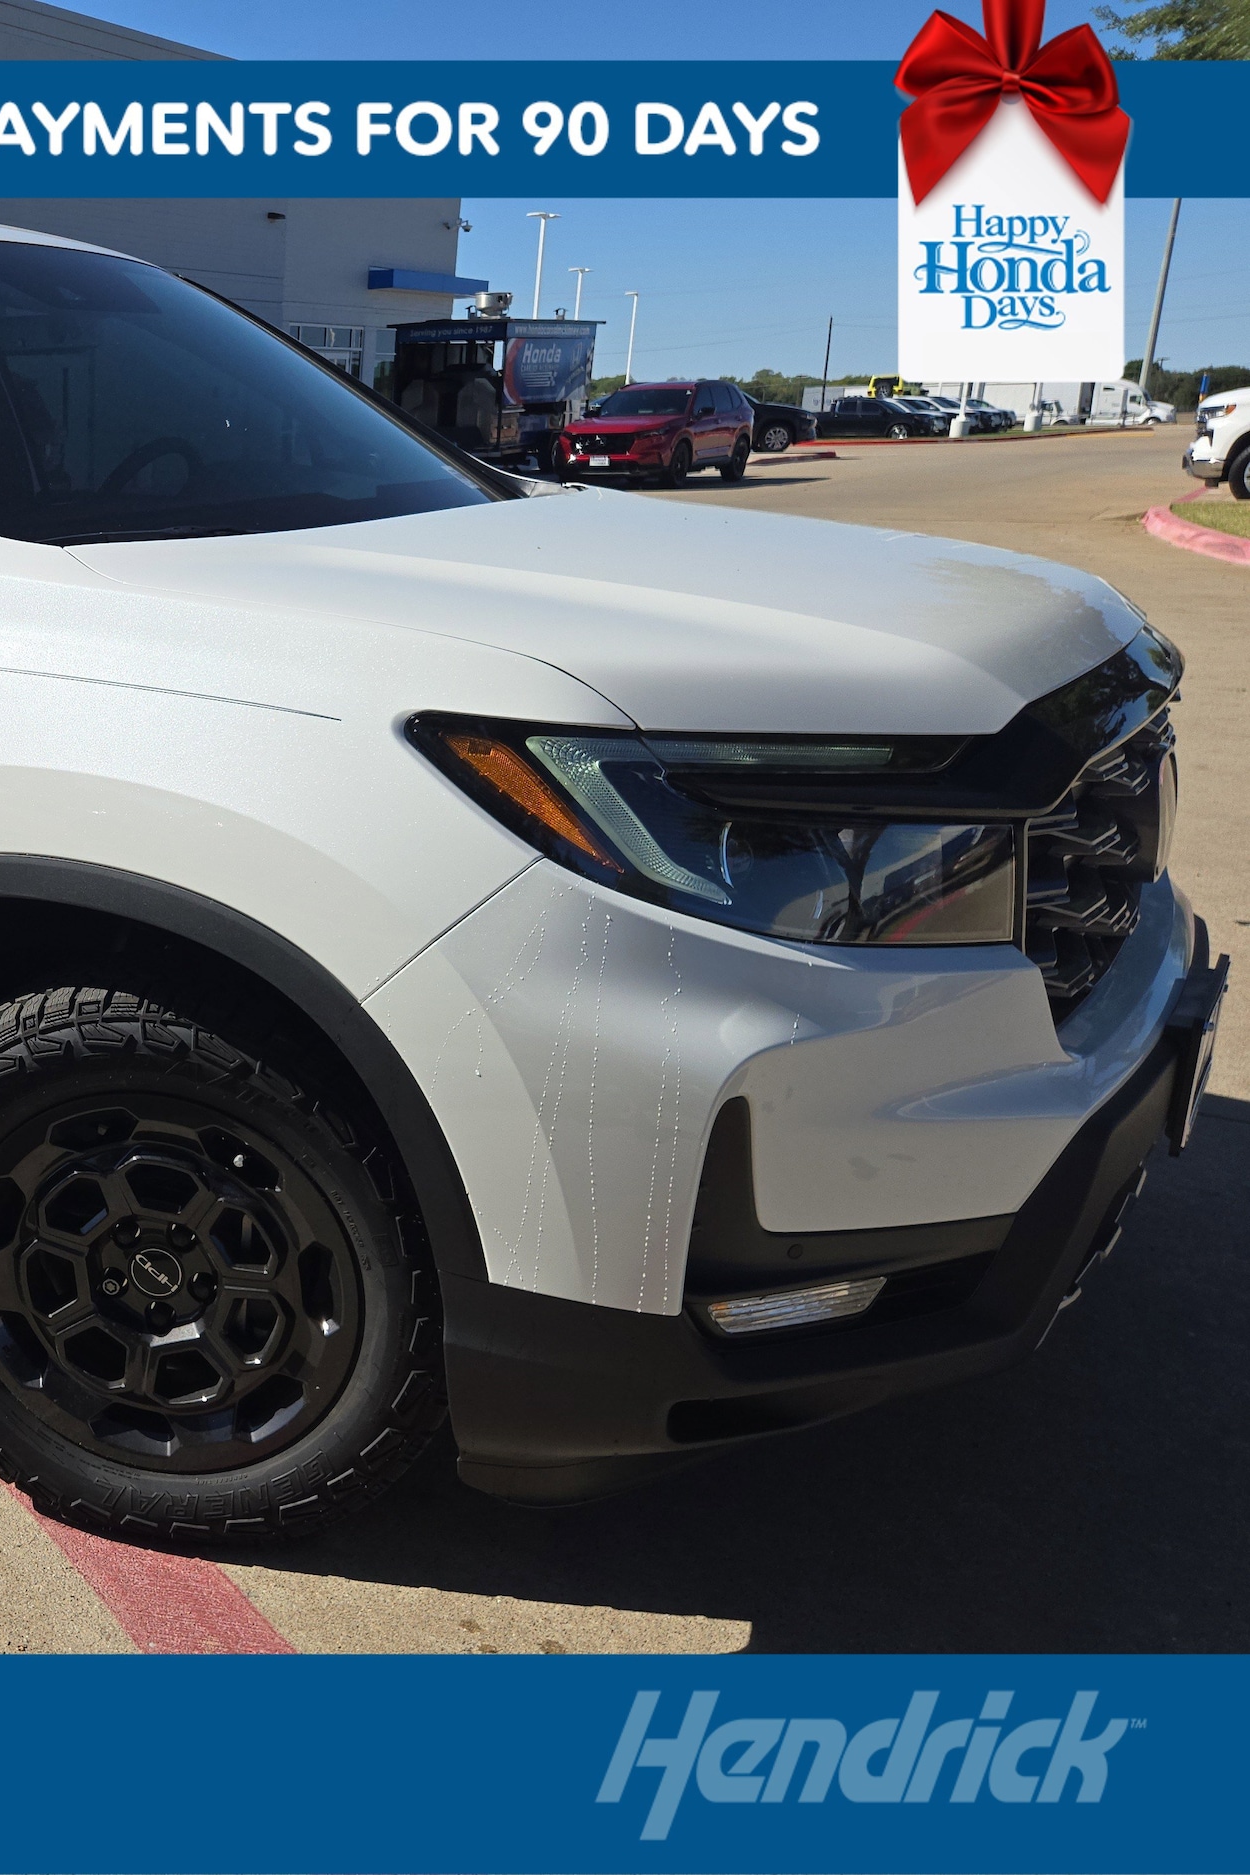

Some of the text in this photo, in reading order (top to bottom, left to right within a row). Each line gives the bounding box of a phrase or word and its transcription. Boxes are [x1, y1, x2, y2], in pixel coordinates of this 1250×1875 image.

[409, 325, 493, 338] Serving you since 1987
[522, 343, 562, 363] Honda
[135, 1253, 178, 1293] HPD
[94, 1450, 333, 1519] GENERAL
